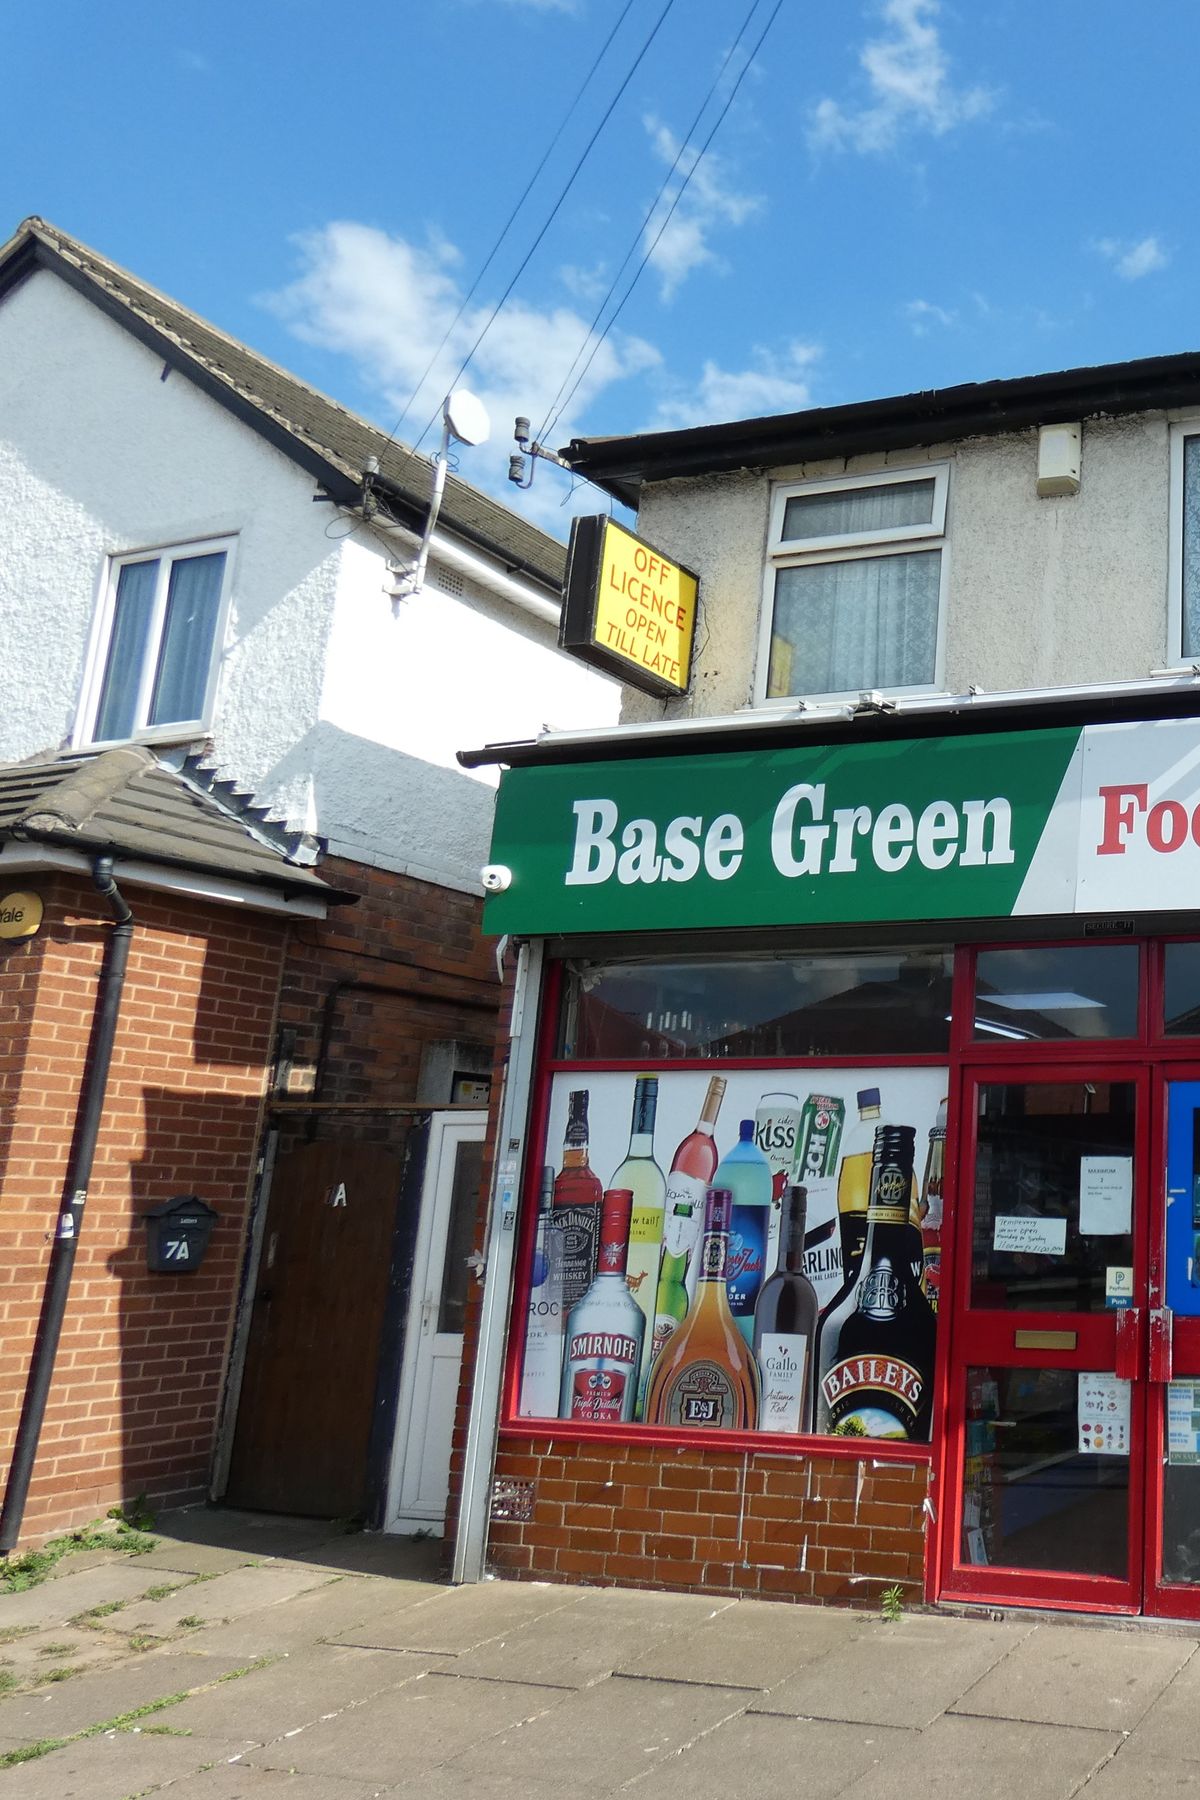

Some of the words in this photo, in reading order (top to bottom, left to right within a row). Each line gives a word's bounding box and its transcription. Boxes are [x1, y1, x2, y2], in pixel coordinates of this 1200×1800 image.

[634, 547, 671, 585] OFF
[609, 563, 687, 632] LICENCE
[625, 608, 667, 647] OPEN
[606, 621, 637, 658] TILL
[642, 644, 681, 681] LATE
[565, 798, 744, 887] Base
[771, 783, 1016, 878] Green
[332, 1182, 347, 1208] A
[165, 1240, 190, 1260] 7A
[553, 1271, 588, 1281] WHISKEY
[571, 1336, 636, 1360] SMIRNOFF
[766, 1357, 798, 1372] Gallo
[827, 1359, 923, 1402] BAILEYS
[581, 1411, 612, 1420] VODKA
[688, 1400, 716, 1419] E&J
[769, 1402, 787, 1414] Red
